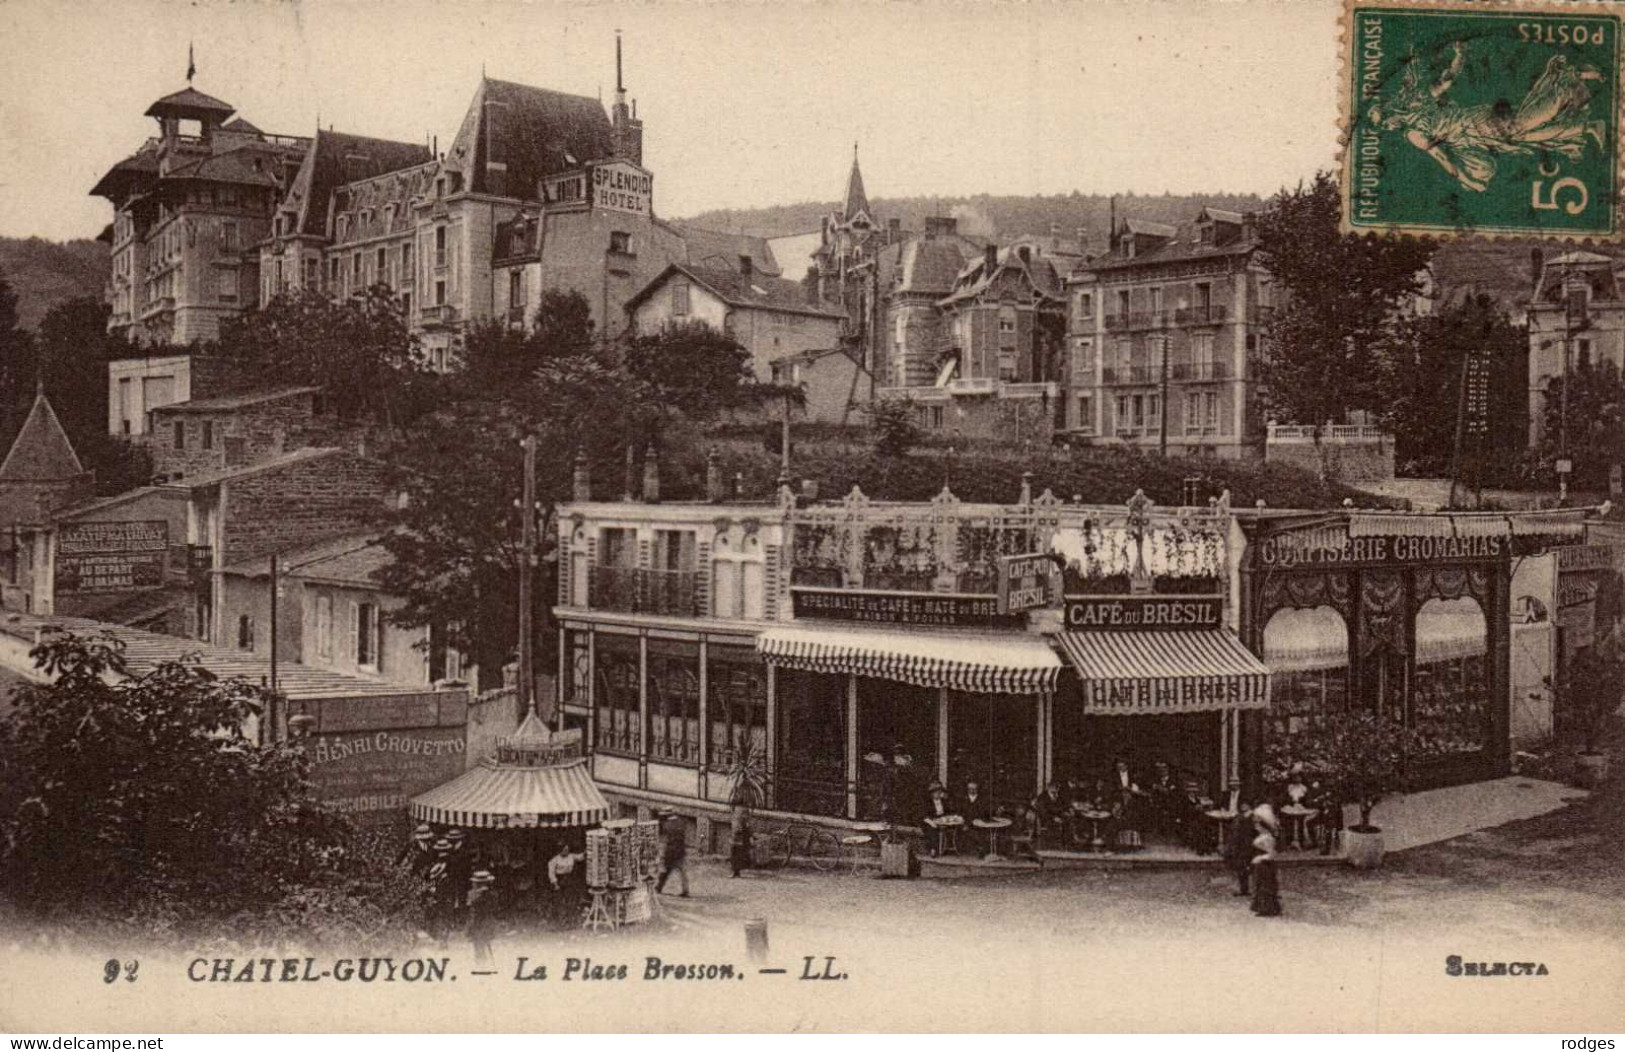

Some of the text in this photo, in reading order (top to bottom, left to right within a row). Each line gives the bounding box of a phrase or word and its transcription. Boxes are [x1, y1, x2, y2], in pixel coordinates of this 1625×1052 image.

[1519, 24, 1604, 44] POSTES
[1363, 18, 1383, 100] FRANÇAISE
[595, 166, 649, 194] SPLENDID
[600, 189, 643, 211] HOTEL
[1070, 601, 1123, 625] CAFÉ
[1142, 601, 1217, 624] BRÉSIL
[315, 737, 371, 764] HENRI
